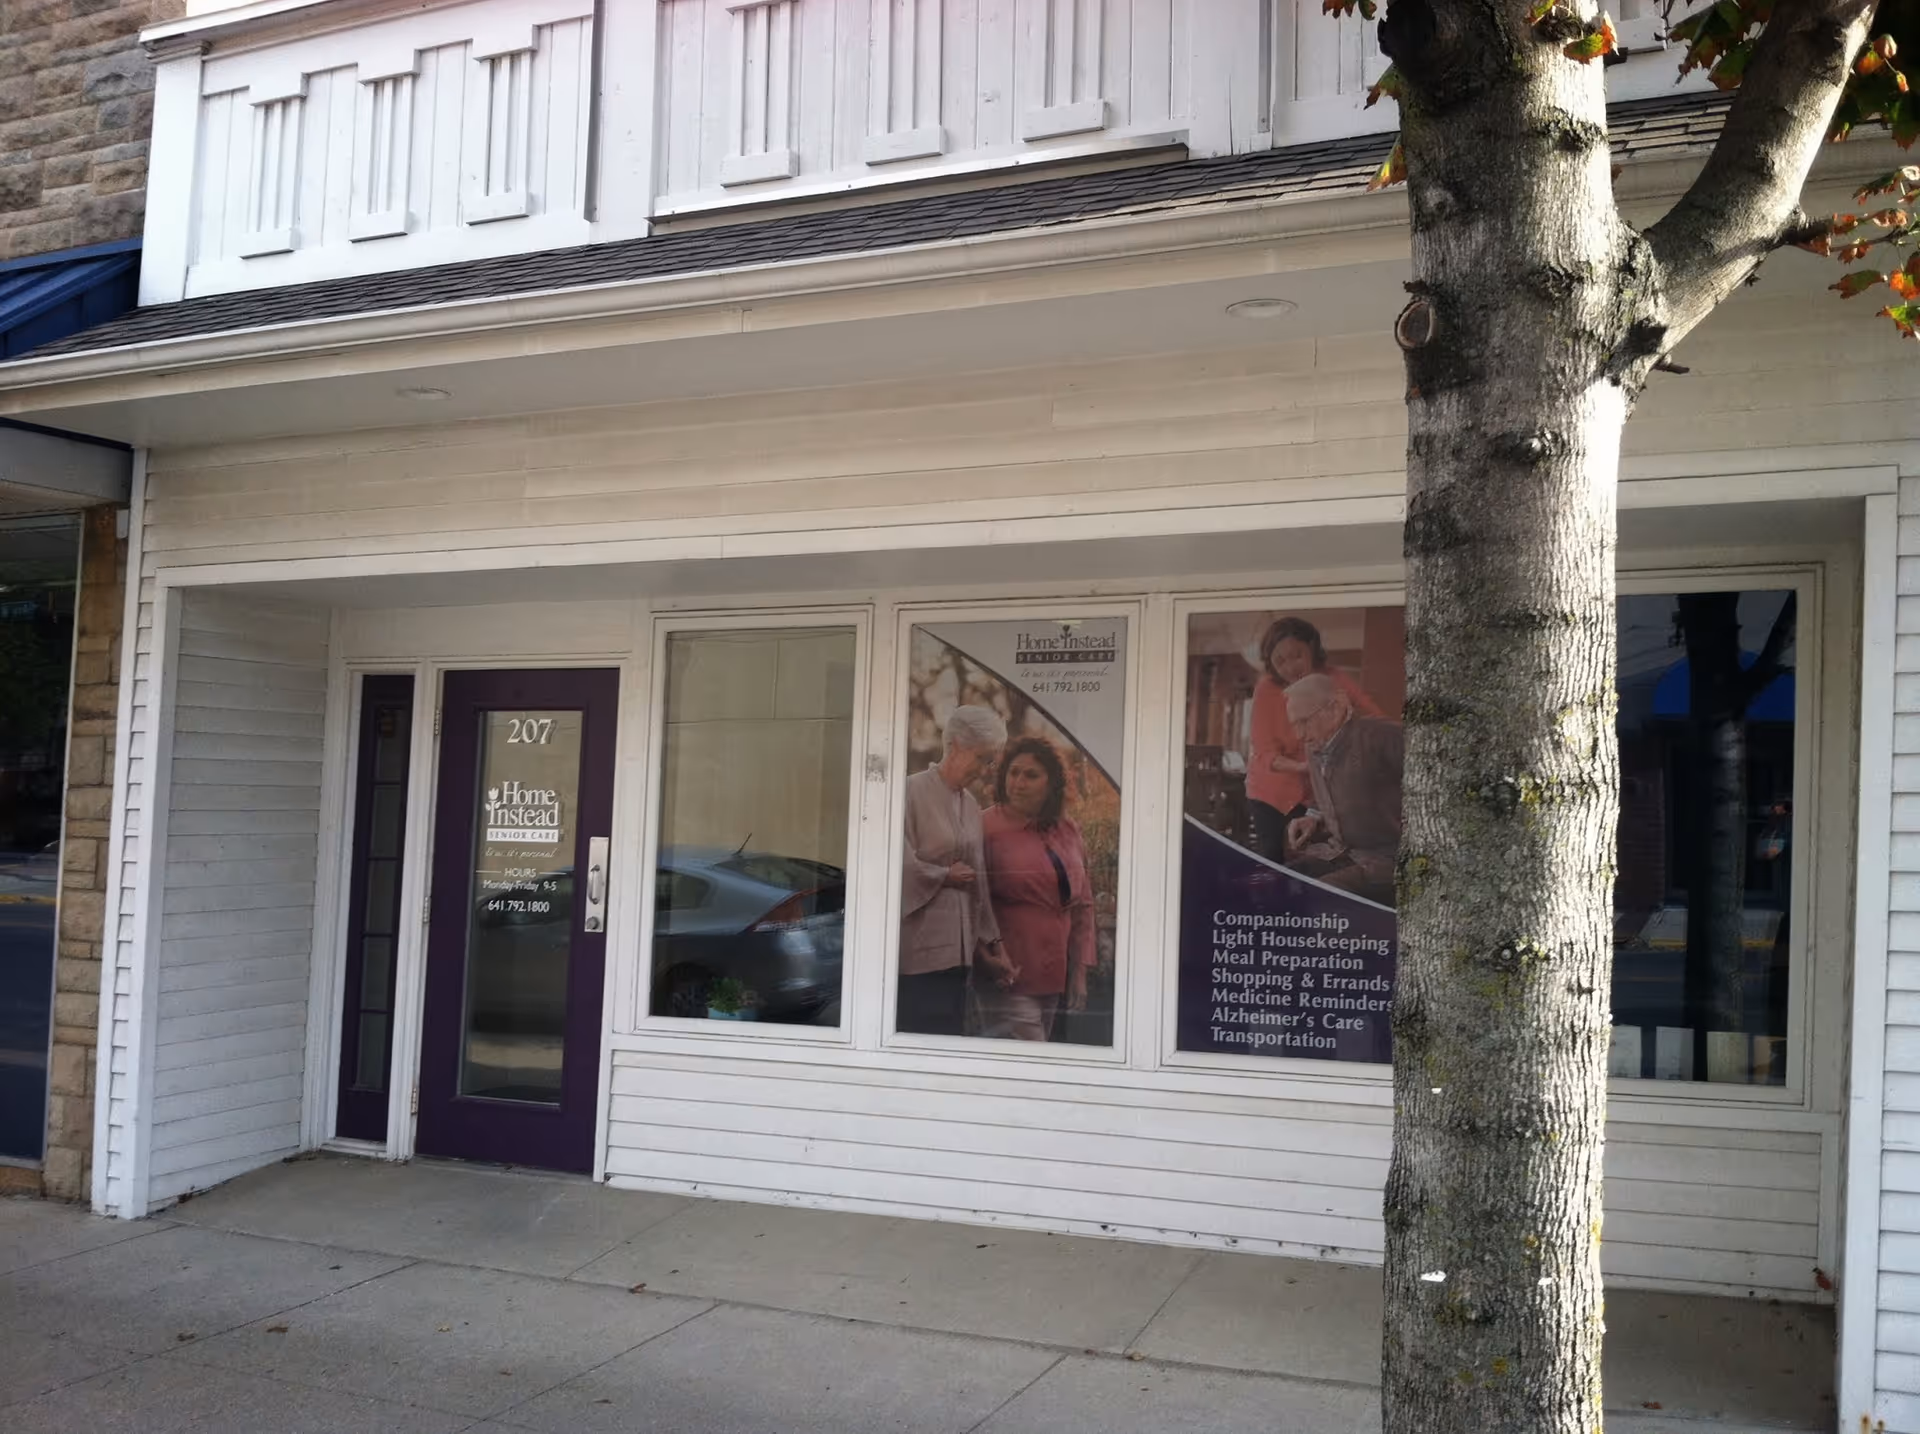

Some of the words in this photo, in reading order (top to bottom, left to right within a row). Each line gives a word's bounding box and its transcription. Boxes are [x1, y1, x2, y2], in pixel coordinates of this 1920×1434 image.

[1017, 633, 1059, 650] Home
[1061, 632, 1116, 649] Instead
[1017, 652, 1069, 663] SENIOR
[506, 719, 552, 744] 207
[502, 781, 556, 806] Home
[488, 800, 560, 827] Instead
[489, 830, 528, 841] SENIOR
[531, 832, 557, 841] CARE
[504, 868, 537, 878] HOURS
[543, 881, 557, 891] 9-5
[488, 900, 550, 913] 641.792.1800
[1213, 910, 1349, 933] Companionship
[1212, 930, 1254, 949] Light
[1261, 931, 1390, 955] Housekeeping
[1212, 949, 1254, 965] Meal
[1262, 951, 1364, 971] Preparation
[1212, 968, 1293, 990] Shopping
[1301, 972, 1315, 987] &
[1323, 974, 1390, 991] Errands
[1211, 988, 1292, 1006] Medicine
[1299, 992, 1393, 1012] Reminders
[1211, 1007, 1315, 1027] Alzheimer's
[1322, 1013, 1365, 1030] Care
[1210, 1026, 1337, 1049] Transportation
